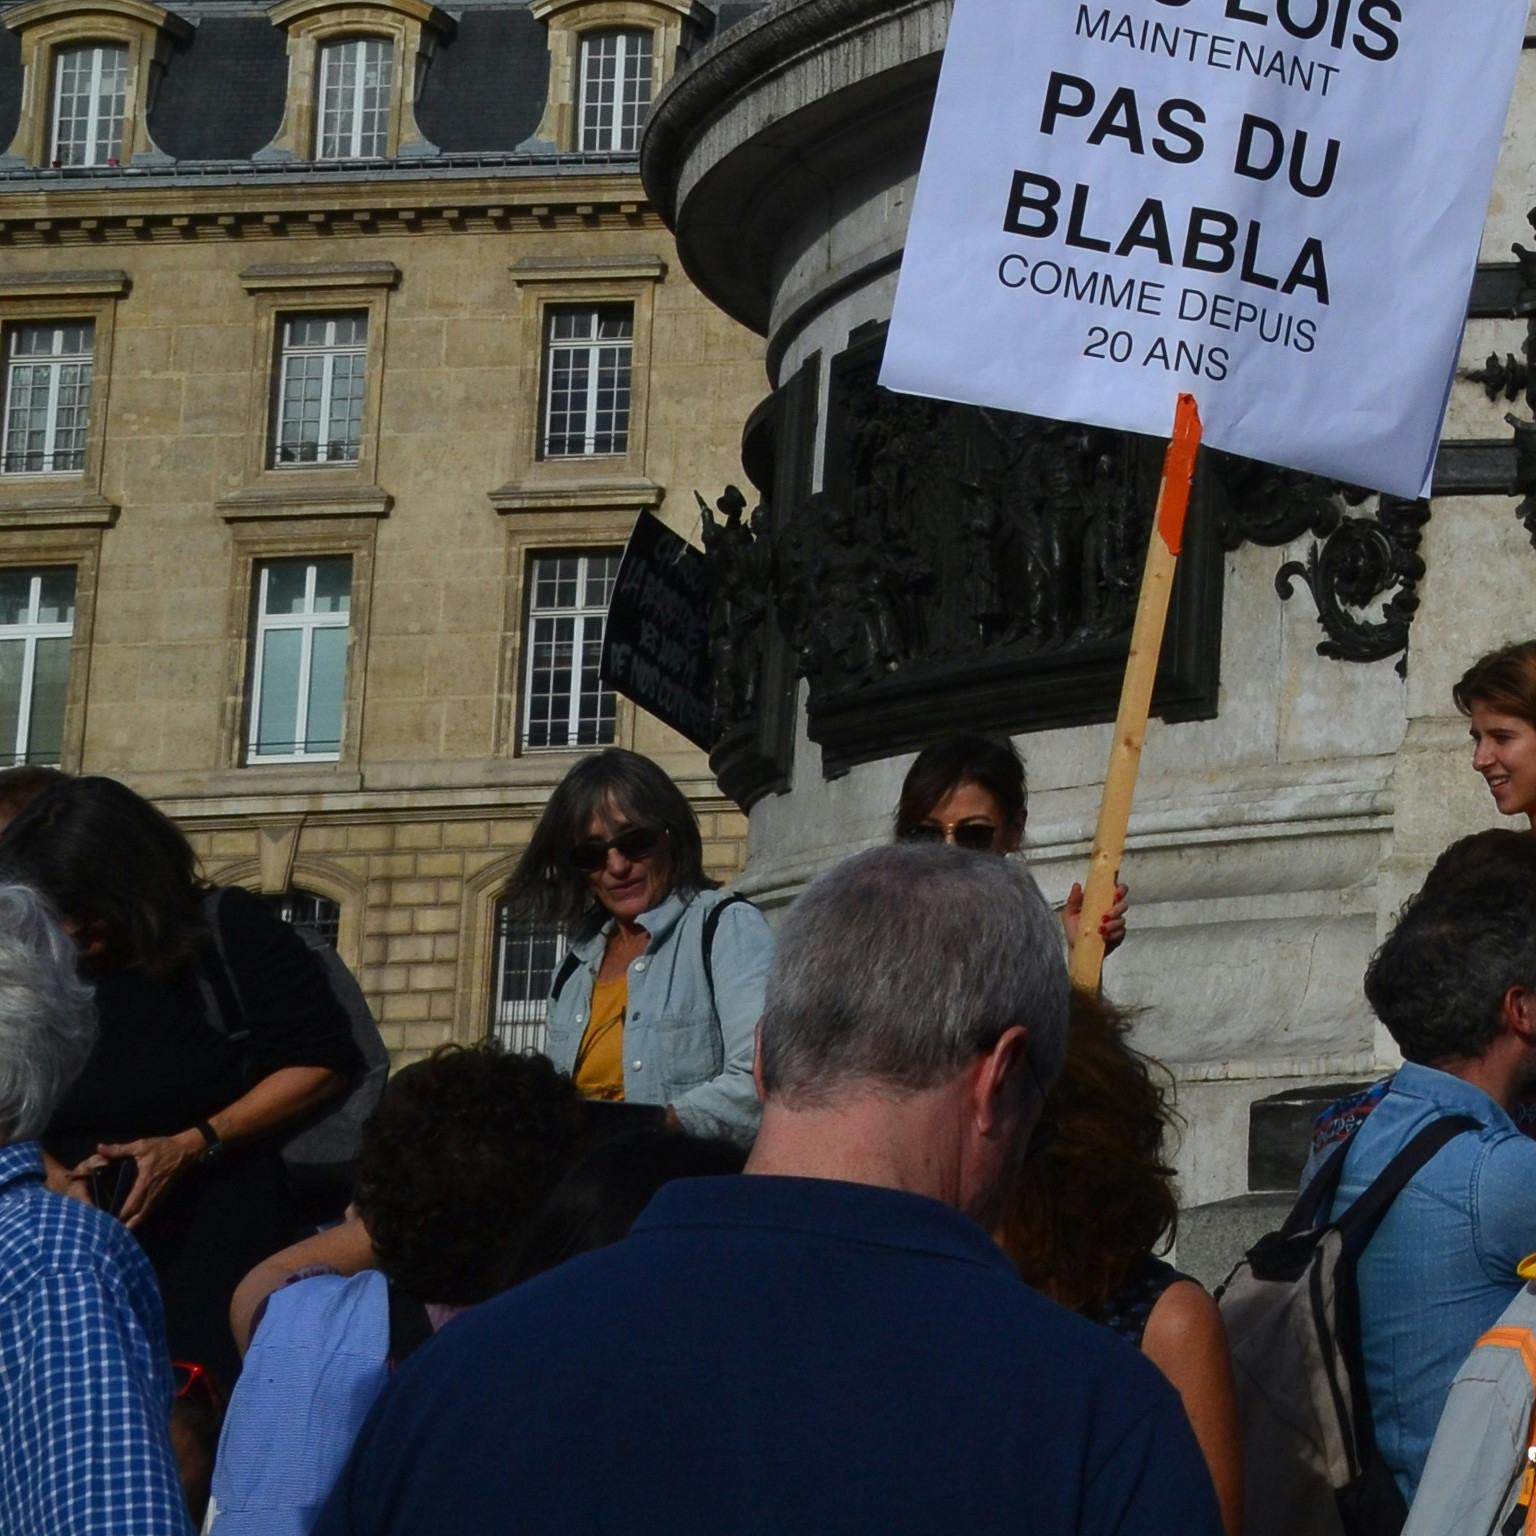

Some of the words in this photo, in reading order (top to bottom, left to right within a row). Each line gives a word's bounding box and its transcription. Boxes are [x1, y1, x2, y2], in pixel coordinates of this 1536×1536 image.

[1075, 4, 1340, 97] MAINTENANT
[1039, 70, 1205, 165] PAS
[1234, 113, 1341, 199] DU
[1002, 169, 1331, 306] BLABLA
[998, 253, 1166, 317] COMME
[1179, 287, 1317, 353] DEPUIS
[1083, 326, 1132, 363] 20
[1143, 338, 1229, 382] ANS
